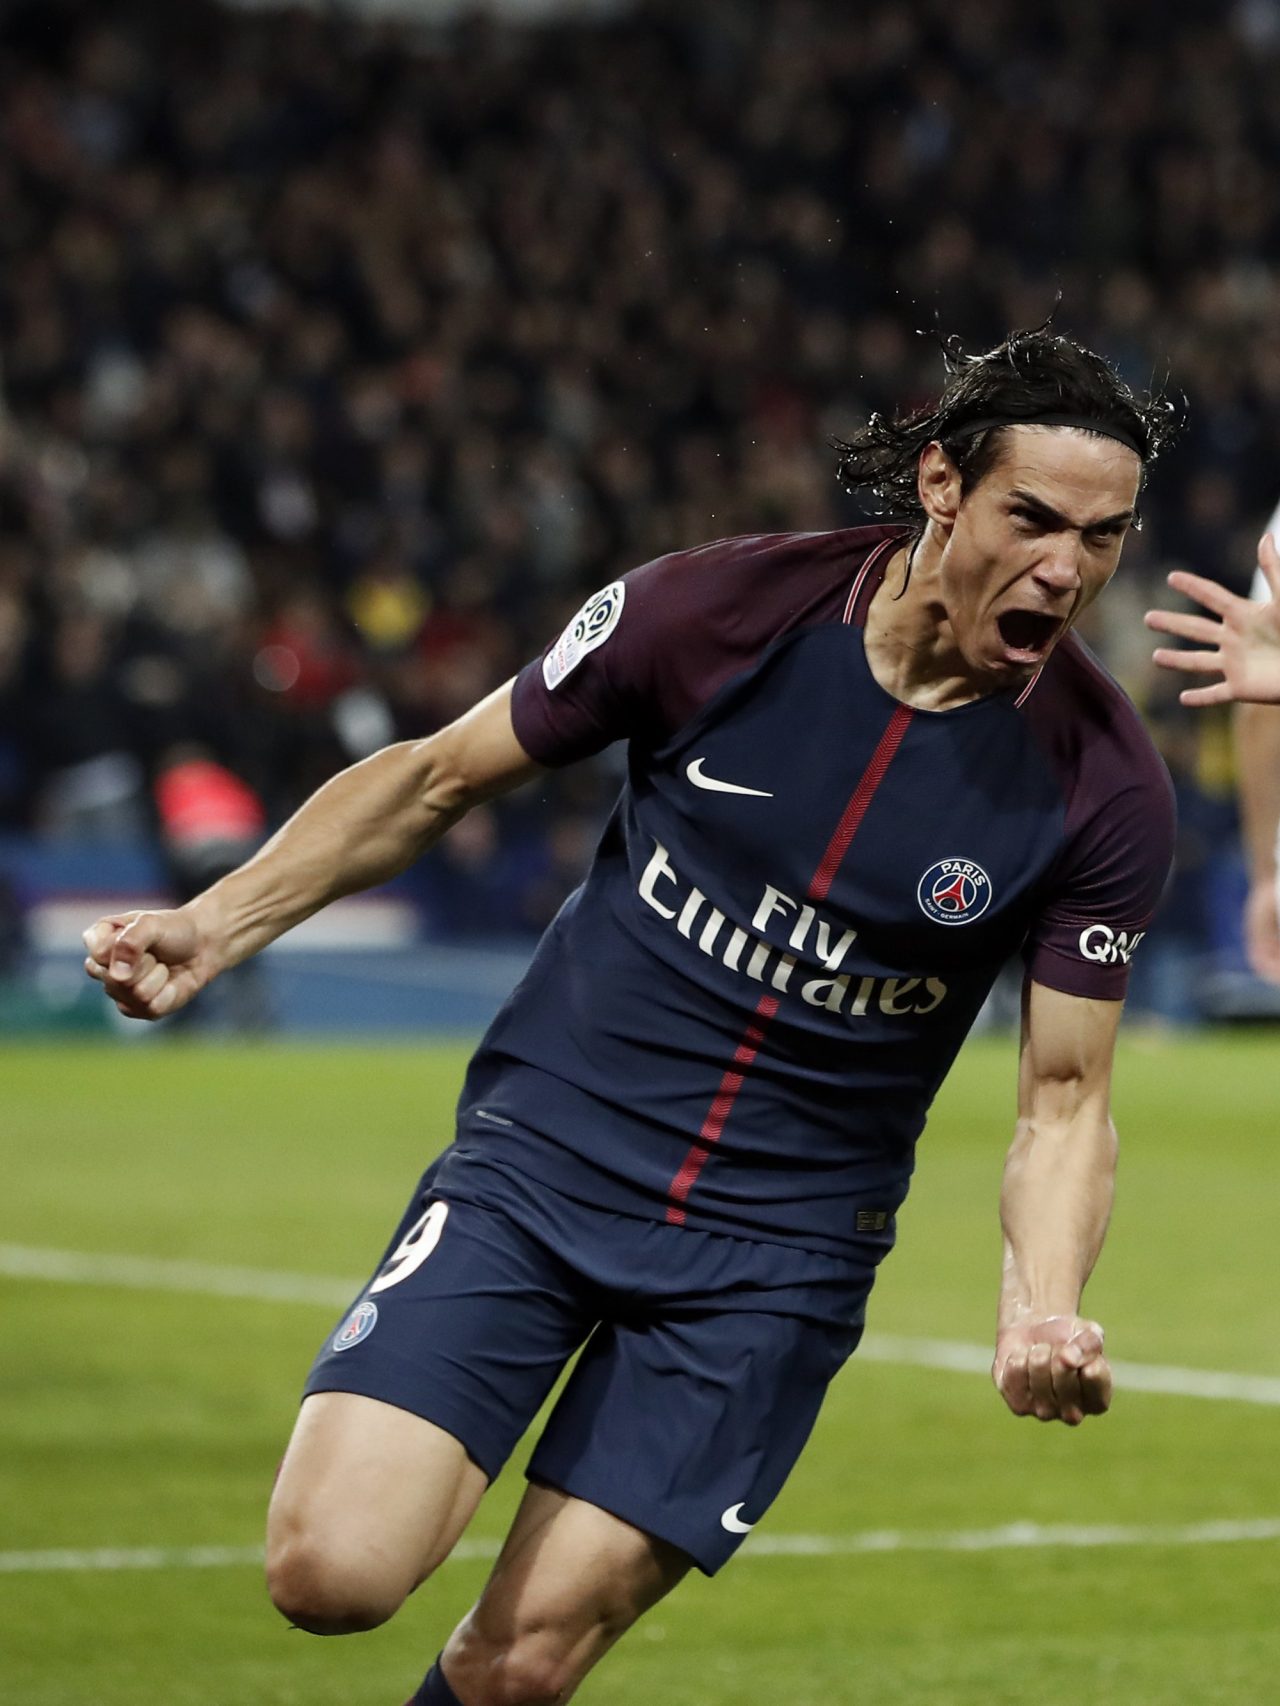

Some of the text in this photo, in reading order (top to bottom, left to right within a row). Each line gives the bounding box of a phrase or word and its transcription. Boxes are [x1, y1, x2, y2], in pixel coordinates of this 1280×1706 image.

[940, 861, 986, 887] PARIS
[752, 883, 858, 972] Fly
[1079, 924, 1146, 964] QN
[368, 1200, 450, 1295] 9
